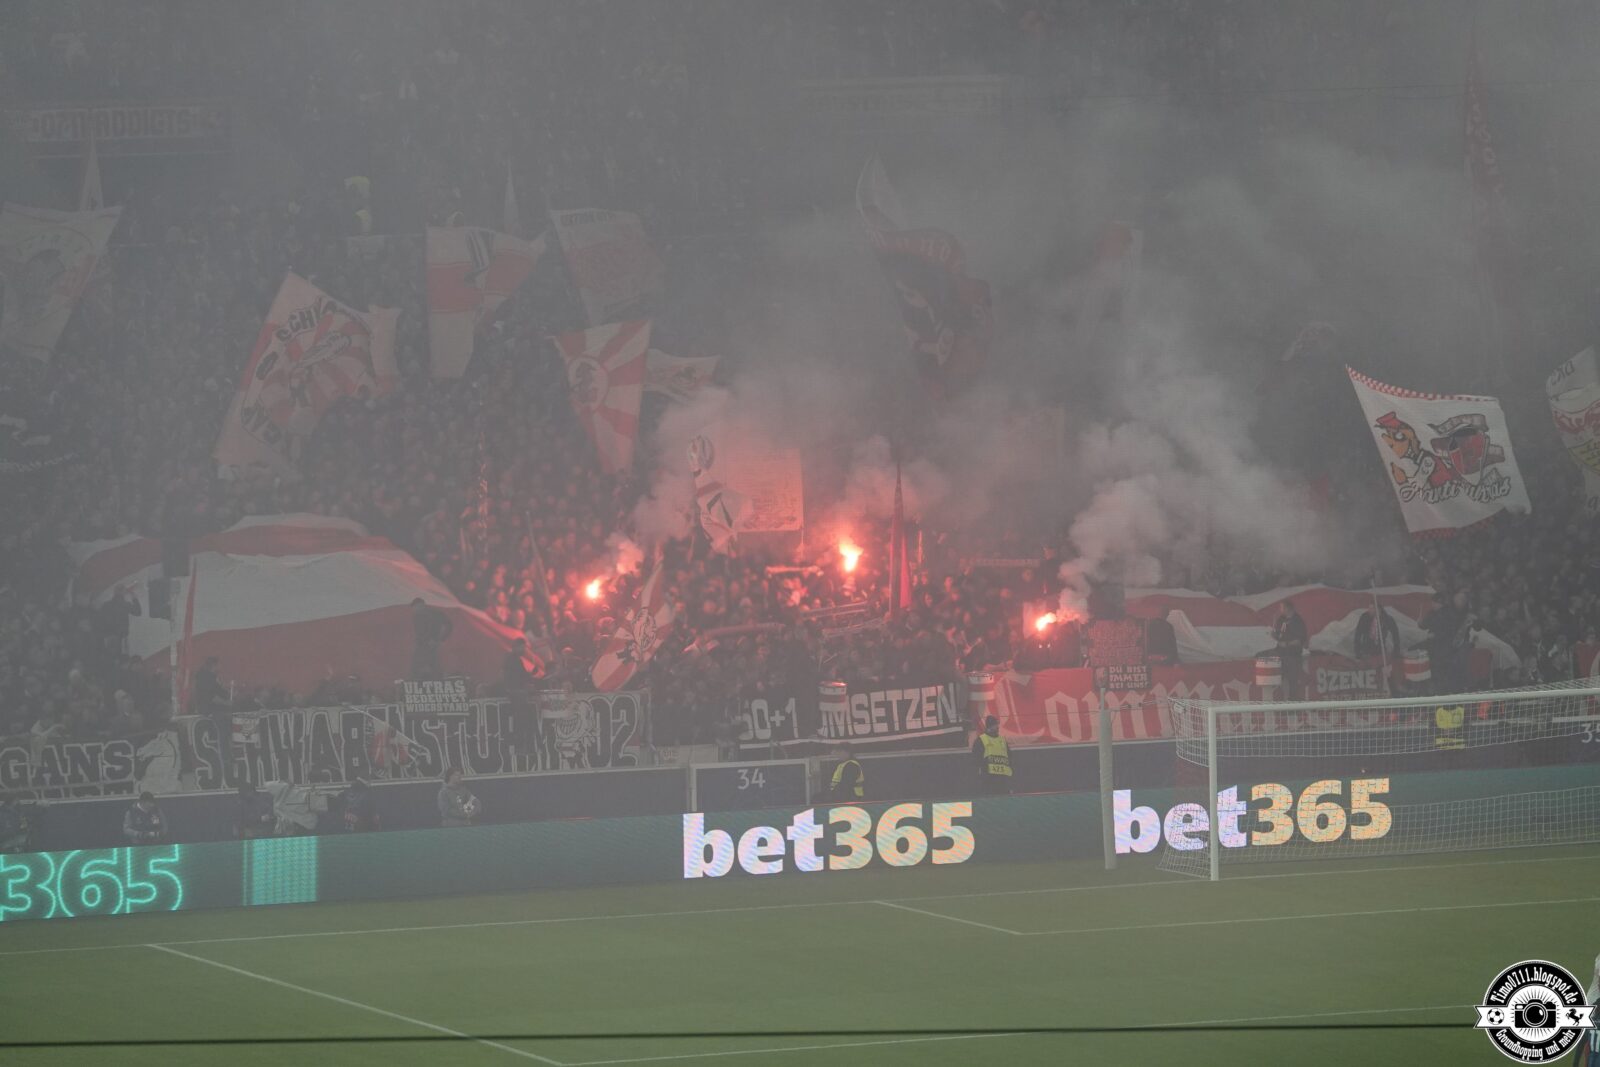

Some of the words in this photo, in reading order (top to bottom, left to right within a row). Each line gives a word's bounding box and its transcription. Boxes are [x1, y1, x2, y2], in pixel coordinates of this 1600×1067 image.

[1109, 665, 1122, 673] DU
[1109, 674, 1148, 682] IMMER
[1316, 667, 1378, 693] SZENE
[403, 680, 466, 694] ULTRAS
[405, 693, 467, 703] BEDEUTET
[406, 703, 469, 712] WIDERSTAND
[588, 694, 642, 769] 02
[0, 740, 136, 790] GANS
[737, 768, 766, 790] 34
[1113, 778, 1391, 855] bet365
[683, 801, 976, 879] bet365
